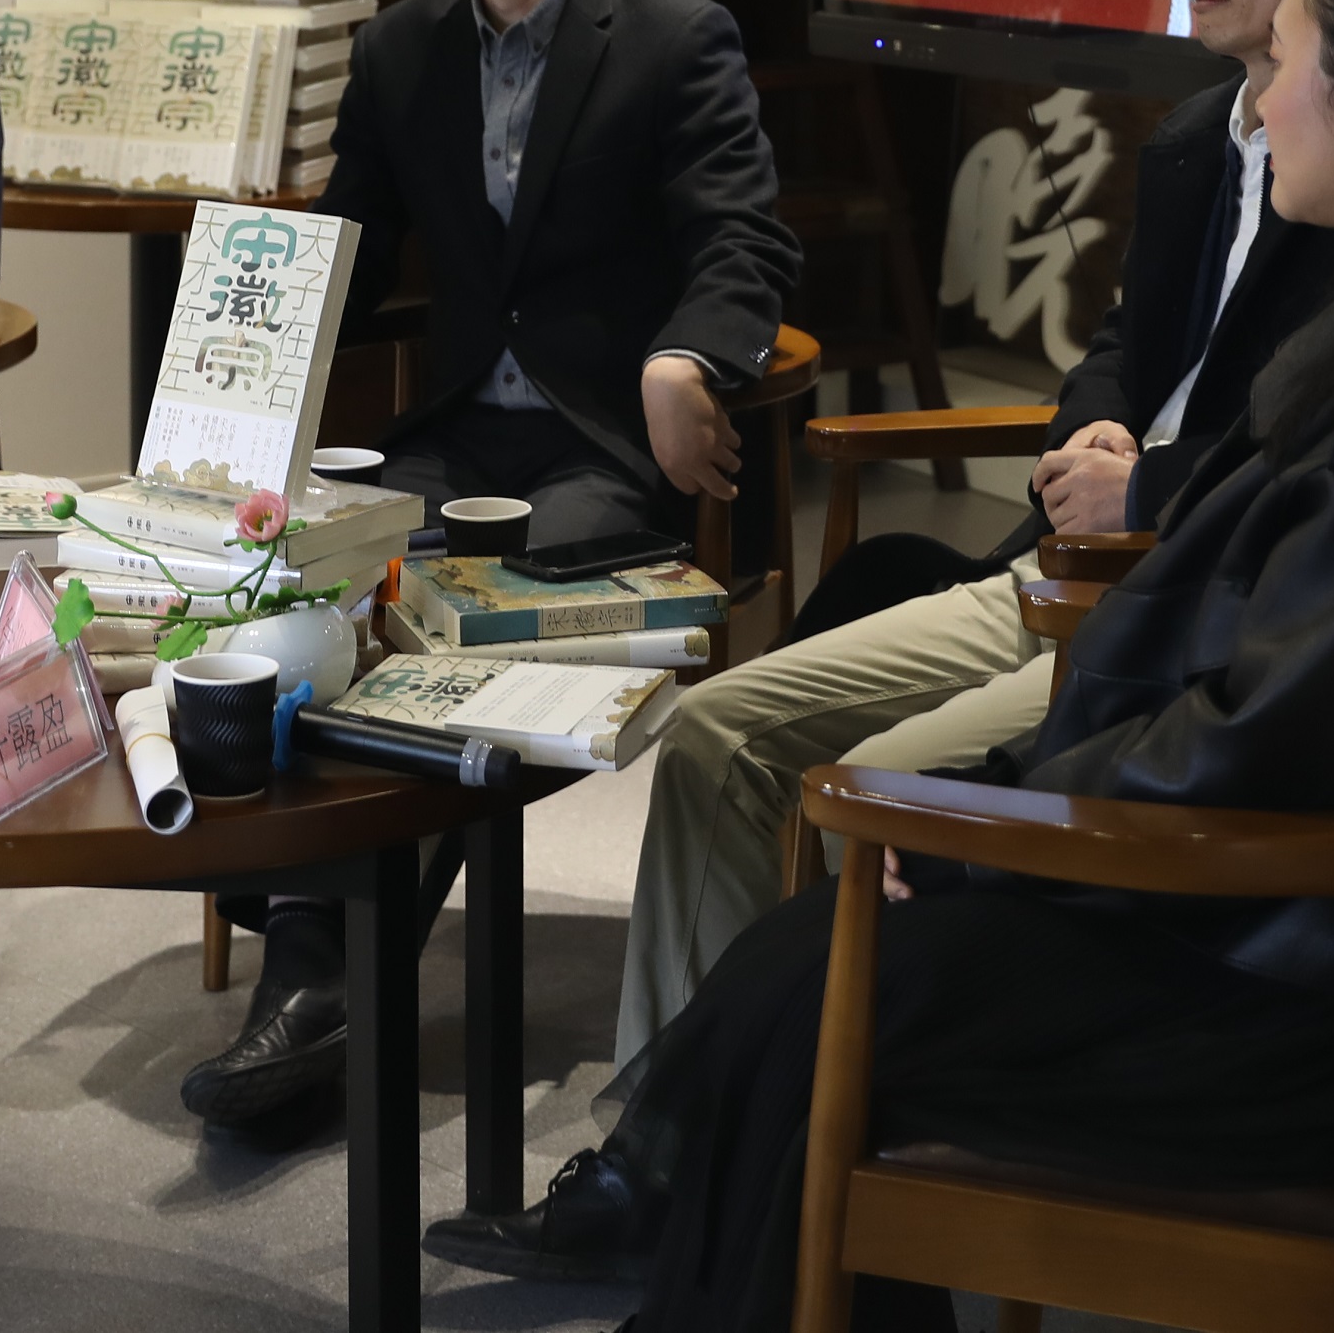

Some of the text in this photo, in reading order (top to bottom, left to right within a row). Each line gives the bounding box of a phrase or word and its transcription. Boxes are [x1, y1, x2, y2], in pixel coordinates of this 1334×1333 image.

[52, 19, 118, 125] 宋徽宗
[157, 25, 225, 132] 宋徽宗
[157, 204, 230, 394] 天才在左
[194, 211, 298, 392] 宋徽宗
[263, 217, 338, 415] 天子在右
